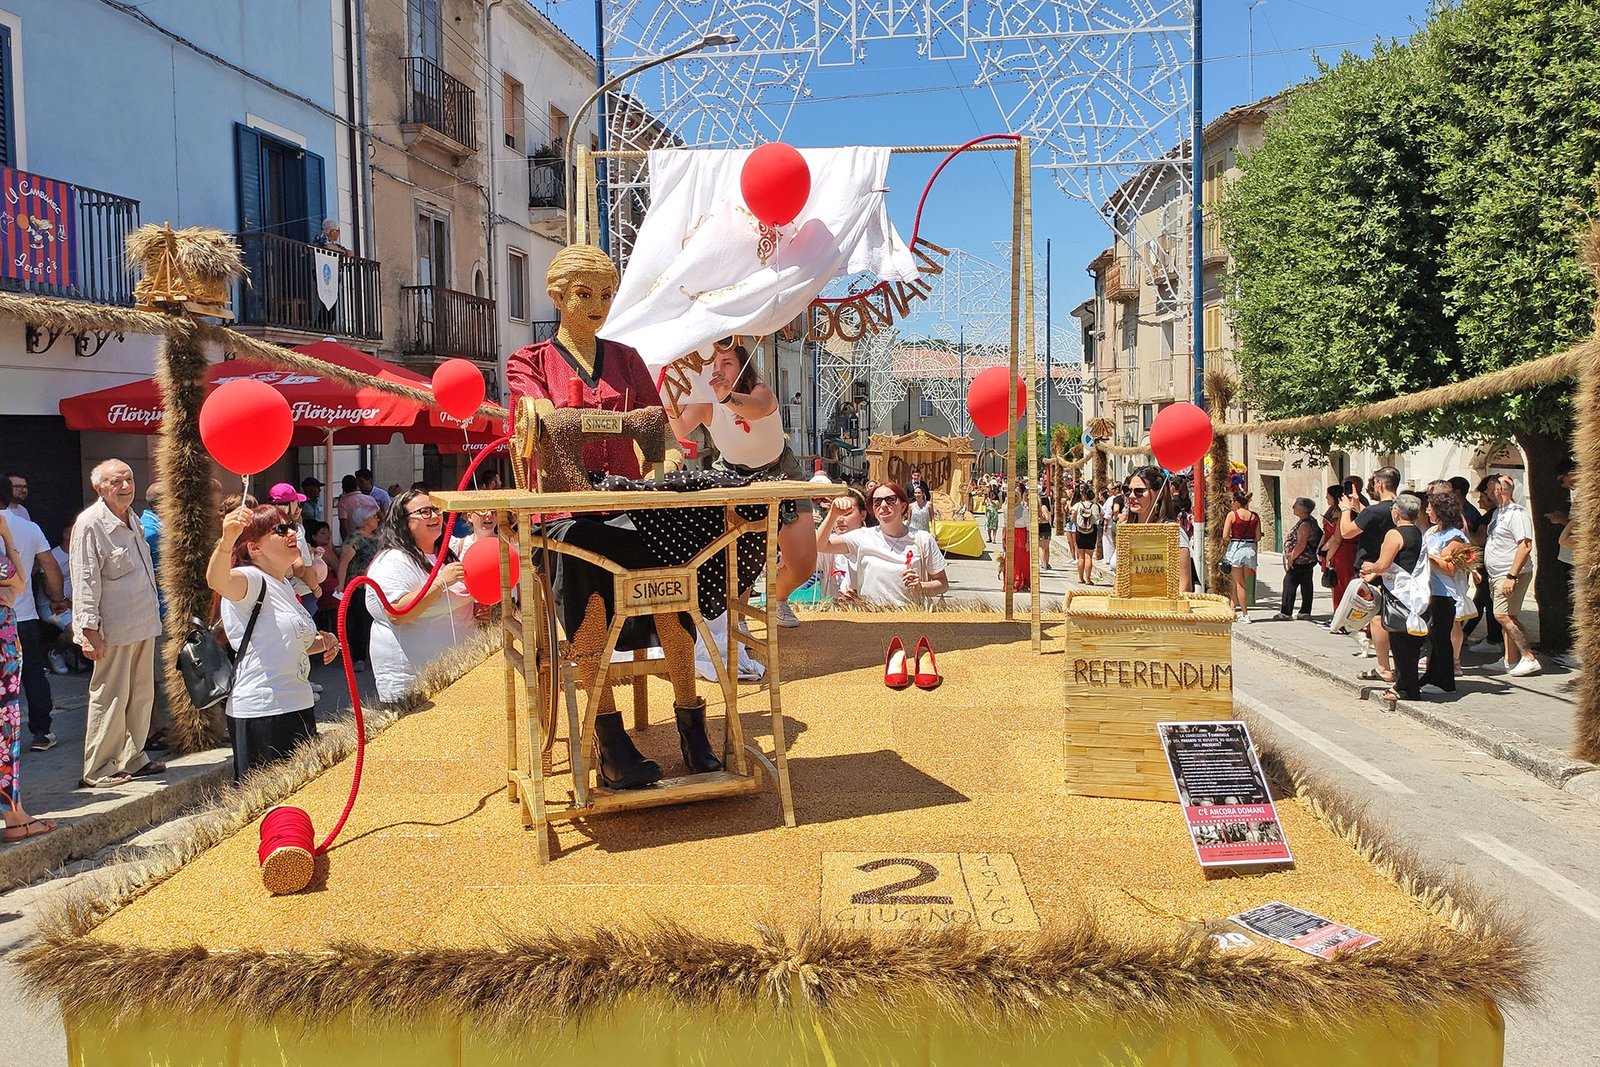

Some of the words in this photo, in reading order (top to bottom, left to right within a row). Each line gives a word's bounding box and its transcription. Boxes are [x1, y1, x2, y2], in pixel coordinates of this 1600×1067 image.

[585, 418, 619, 431] SINGER
[632, 581, 683, 599] SINGER
[1074, 659, 1232, 693] REFERENDUM
[1198, 807, 1209, 816] C'È
[1209, 807, 1237, 816] ANCORA
[1237, 806, 1265, 815] DOMANI
[850, 857, 954, 905] 2
[834, 907, 972, 925] GIUGNO
